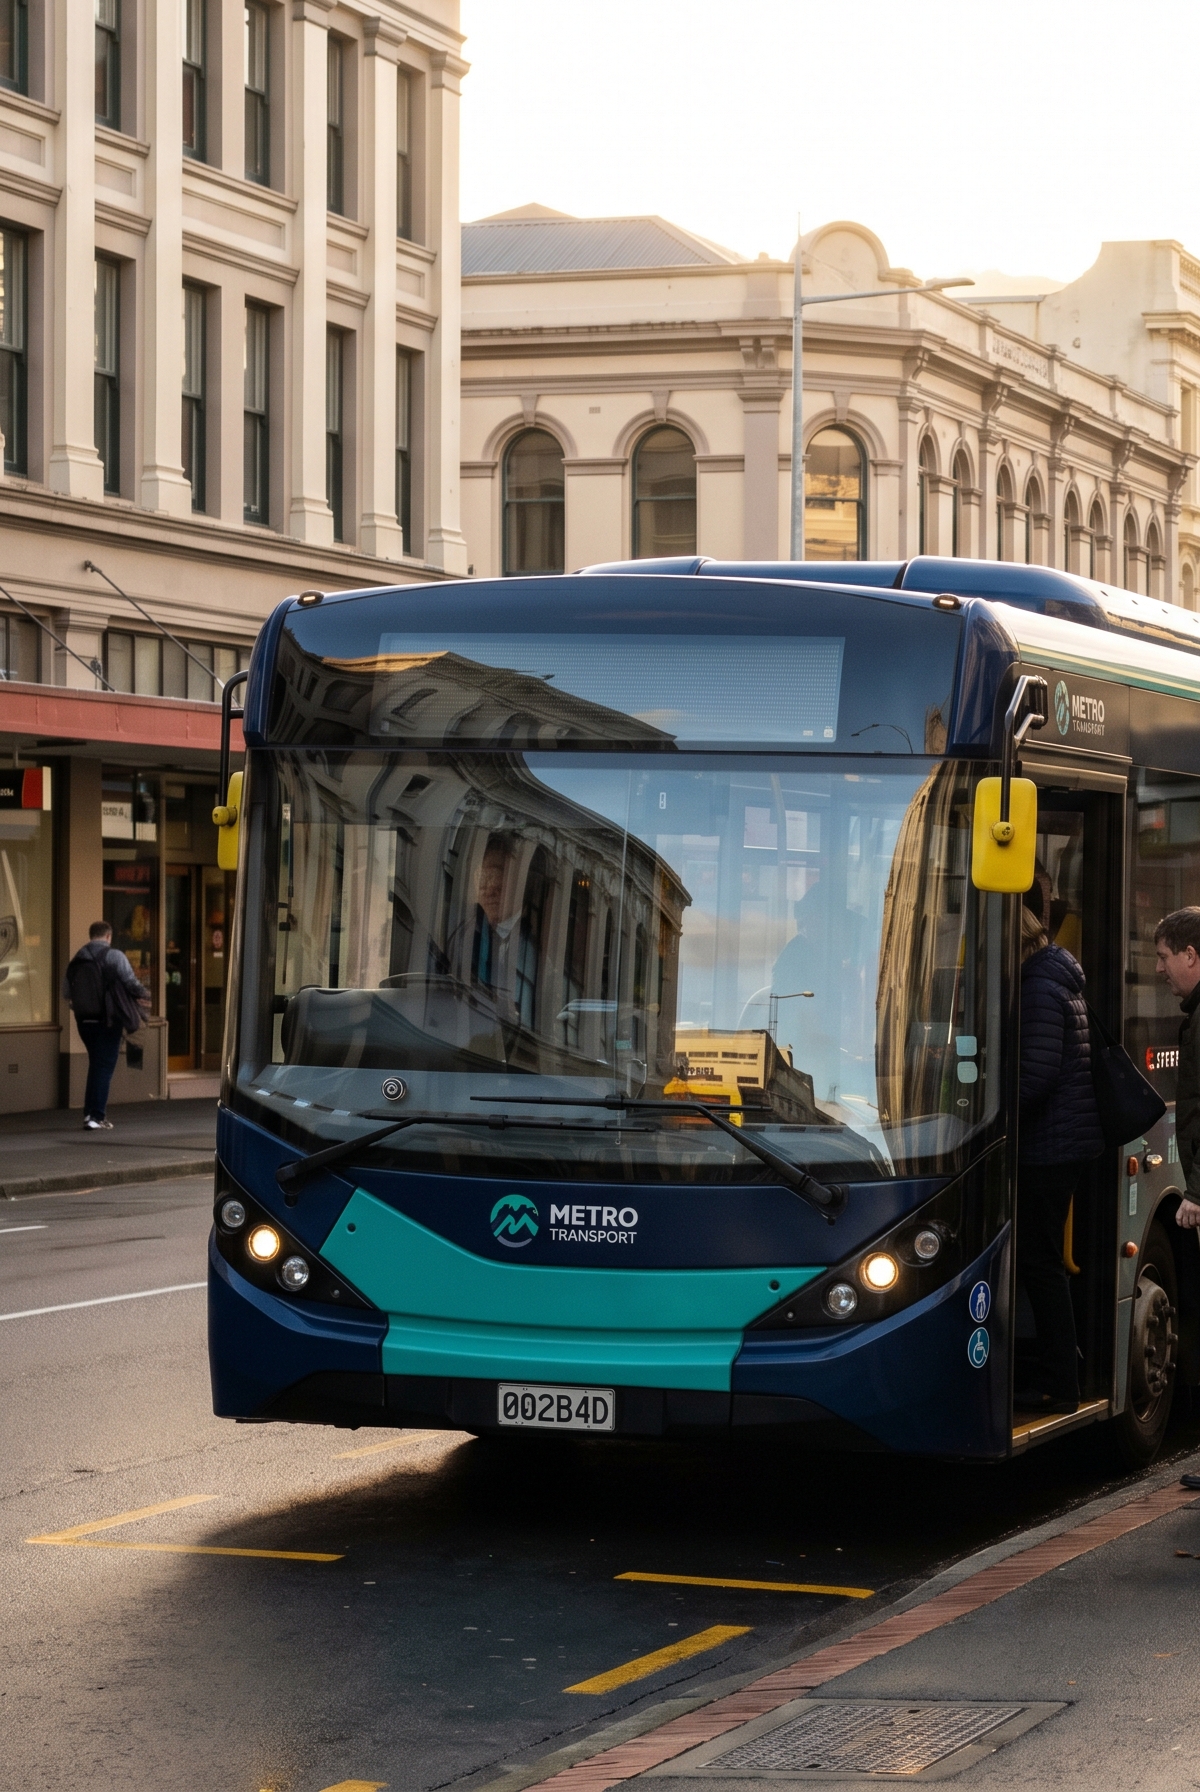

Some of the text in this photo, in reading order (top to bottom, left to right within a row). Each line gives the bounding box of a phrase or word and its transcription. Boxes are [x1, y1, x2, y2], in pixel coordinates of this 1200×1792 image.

[1072, 694, 1105, 723] METRO
[549, 1203, 639, 1228] METRO
[549, 1228, 638, 1245] TRANSPORT
